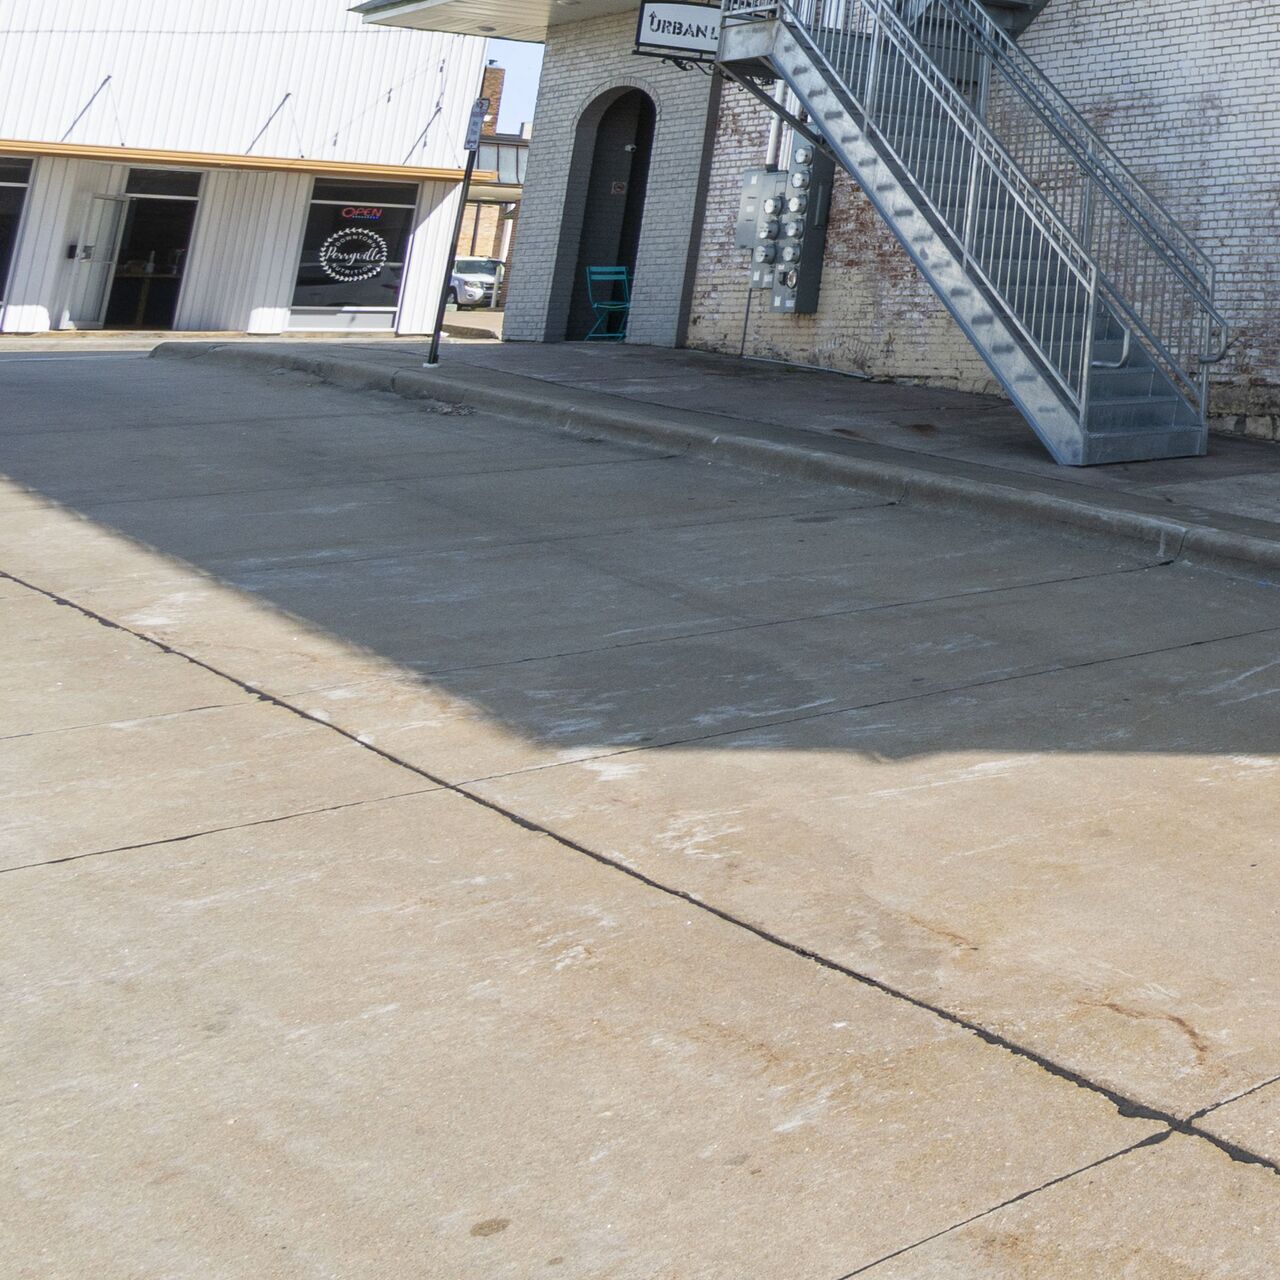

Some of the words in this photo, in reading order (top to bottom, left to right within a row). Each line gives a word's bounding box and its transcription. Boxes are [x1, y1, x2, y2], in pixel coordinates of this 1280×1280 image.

[648, 11, 708, 40] URBAN
[342, 207, 383, 218] OPEN
[335, 235, 377, 248] DOWNTOWN
[325, 246, 382, 266] Perryville
[331, 263, 373, 274] NUTRITION
